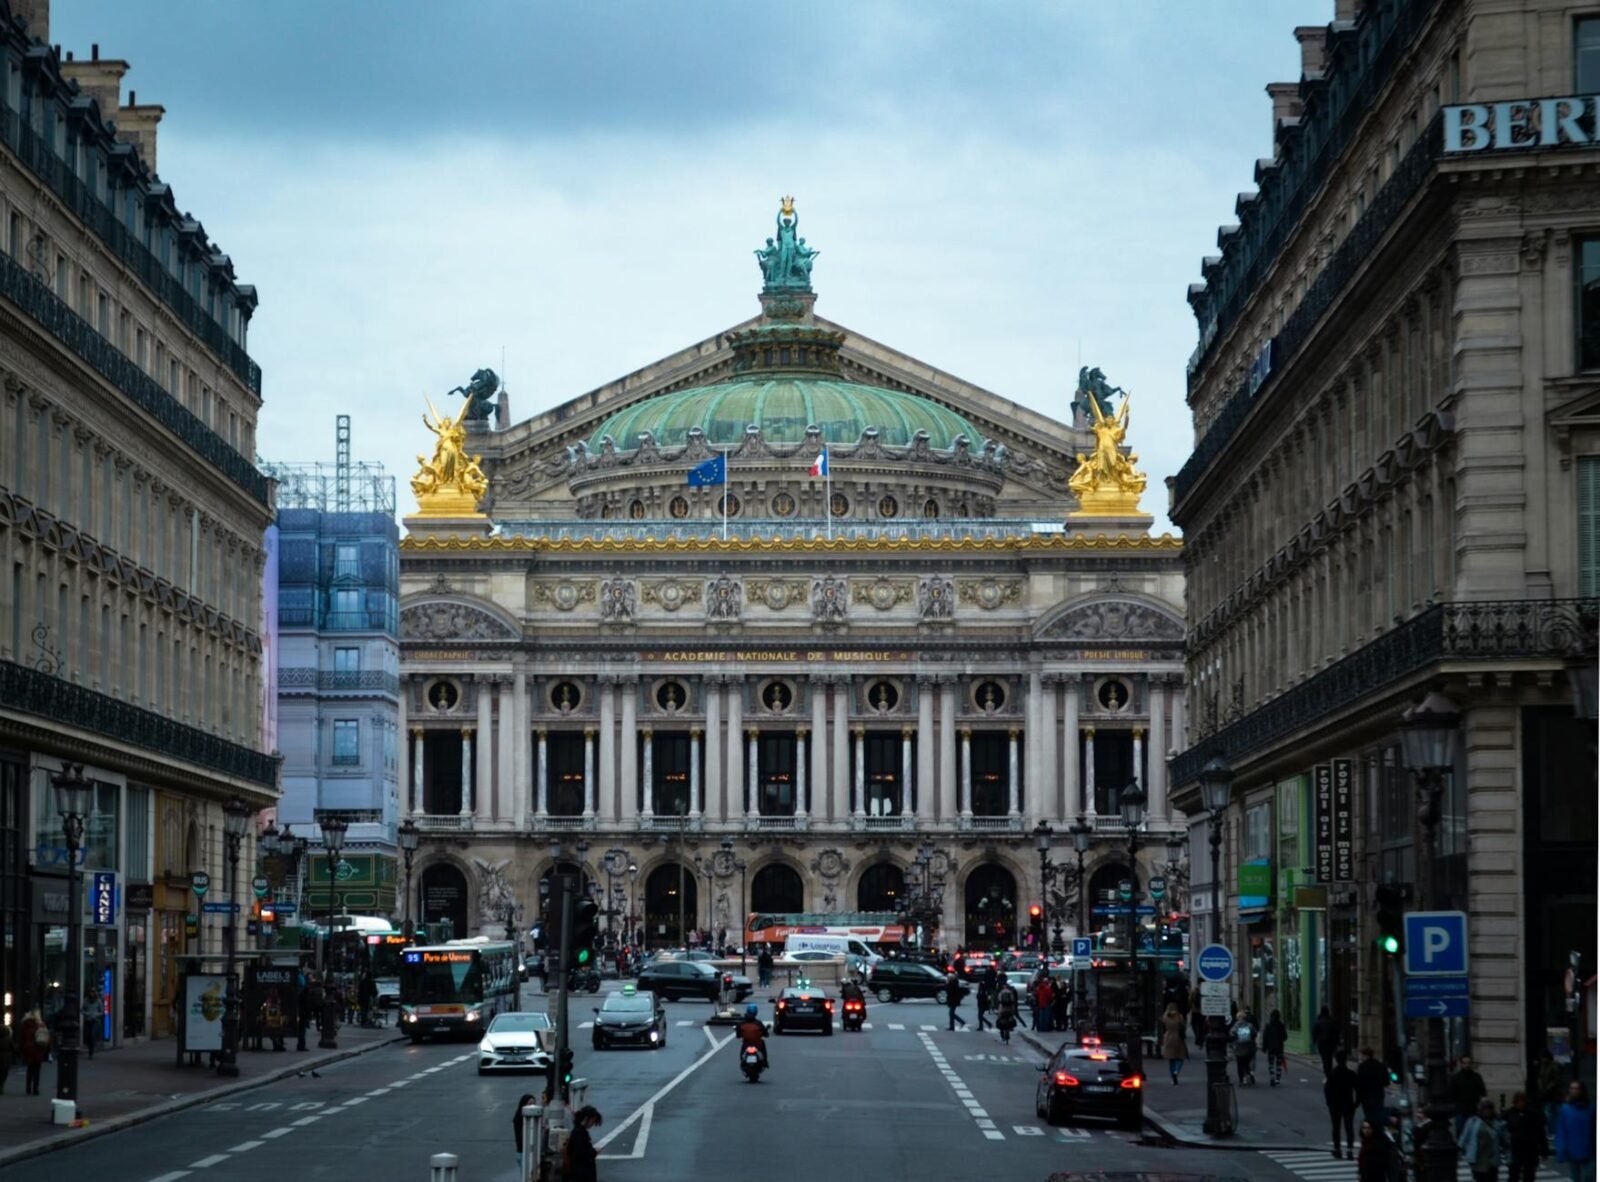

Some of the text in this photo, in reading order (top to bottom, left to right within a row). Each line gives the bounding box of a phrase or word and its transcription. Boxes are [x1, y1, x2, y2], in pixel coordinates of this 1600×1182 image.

[664, 652, 891, 661] ACADEMIE NATIONALE DE MUSIQUE
[1319, 769, 1330, 880] royal air maroc
[1337, 763, 1349, 878] royal air maroc
[193, 876, 208, 884] BUS
[254, 879, 268, 887] BUS
[1150, 880, 1164, 889] BUS
[99, 874, 110, 923] CHANGE
[1077, 942, 1086, 954] P
[1423, 926, 1451, 964] P
[407, 954, 419, 962] 95
[256, 970, 283, 979] LABEL
